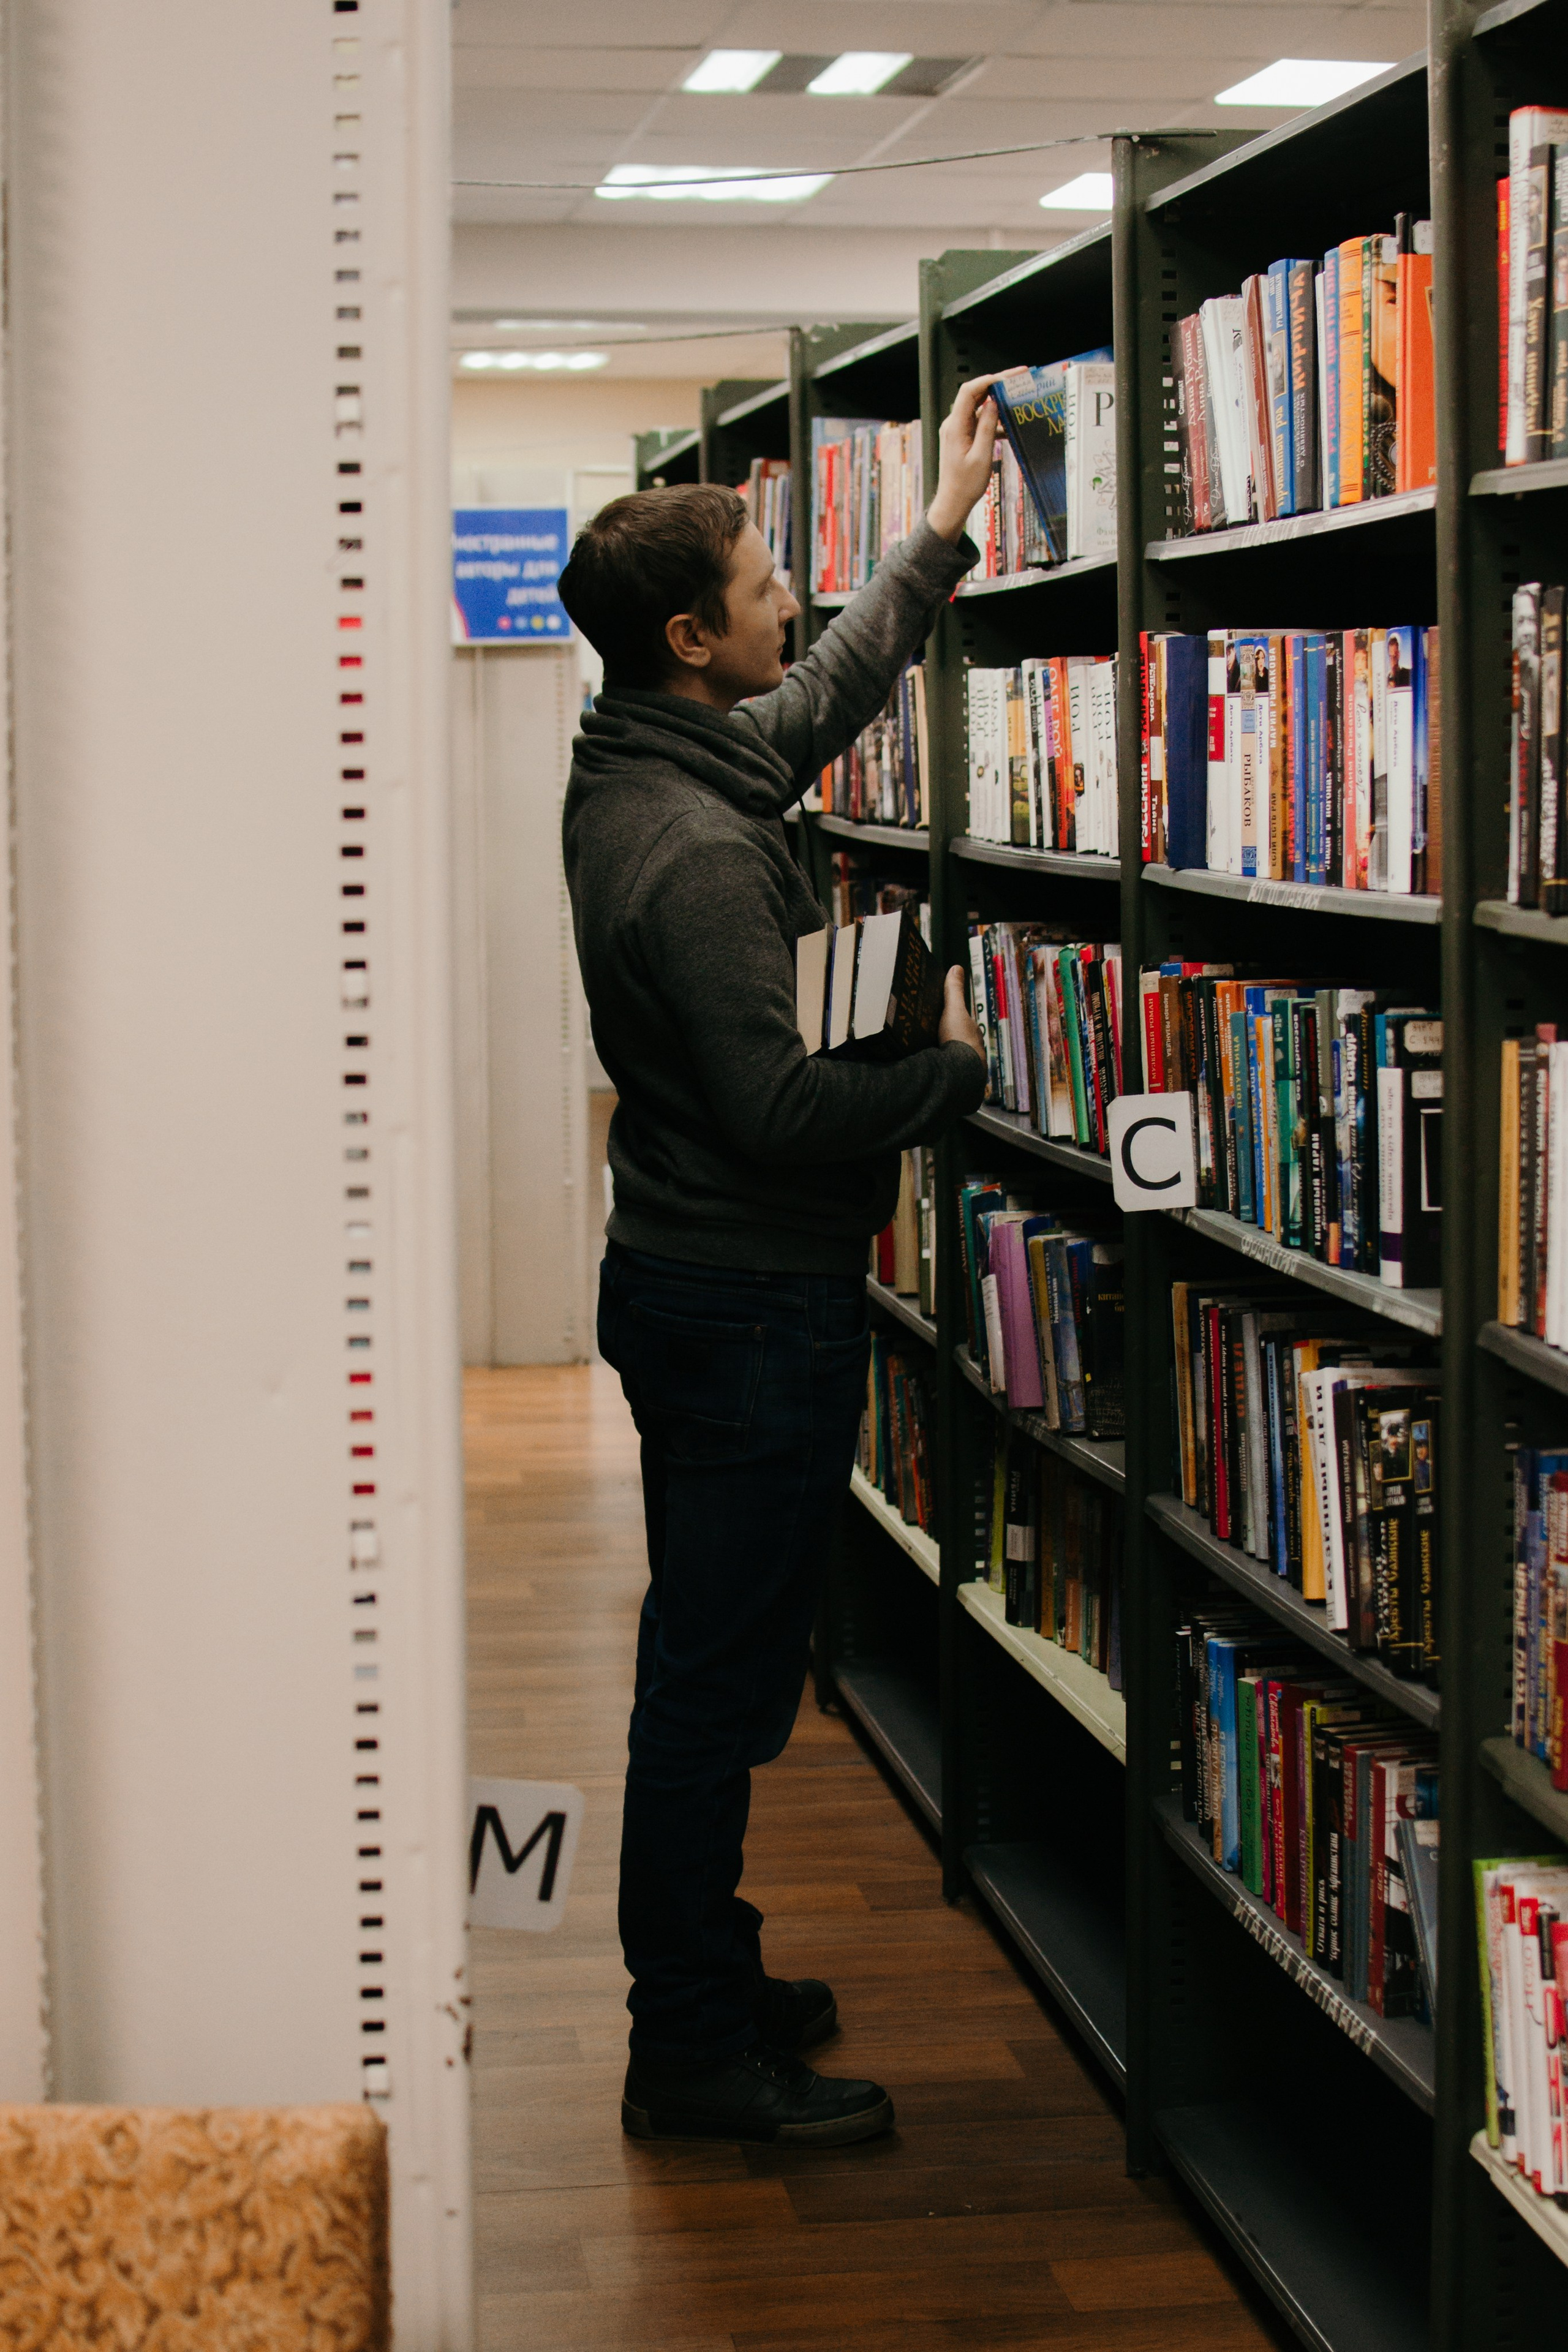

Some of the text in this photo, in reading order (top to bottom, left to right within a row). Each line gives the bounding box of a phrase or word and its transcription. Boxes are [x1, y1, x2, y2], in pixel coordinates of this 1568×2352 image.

[1050, 666, 1061, 713] ОЛЕГ
[1052, 720, 1063, 759] РОЙ
[1243, 753, 1252, 828] РЫБАКОВ
[1231, 1036, 1243, 1110] ПОПУТЧИЦА
[1345, 1033, 1357, 1083] Садур
[1120, 1116, 1182, 1191] С
[1311, 1133, 1322, 1246] ТАНКОВЫЙ ТАРАН
[469, 1804, 567, 1902] М
[1329, 1832, 1341, 1893] Афганистана
[1317, 1915, 1326, 1954] Отвага
[1318, 1905, 1325, 1914] и
